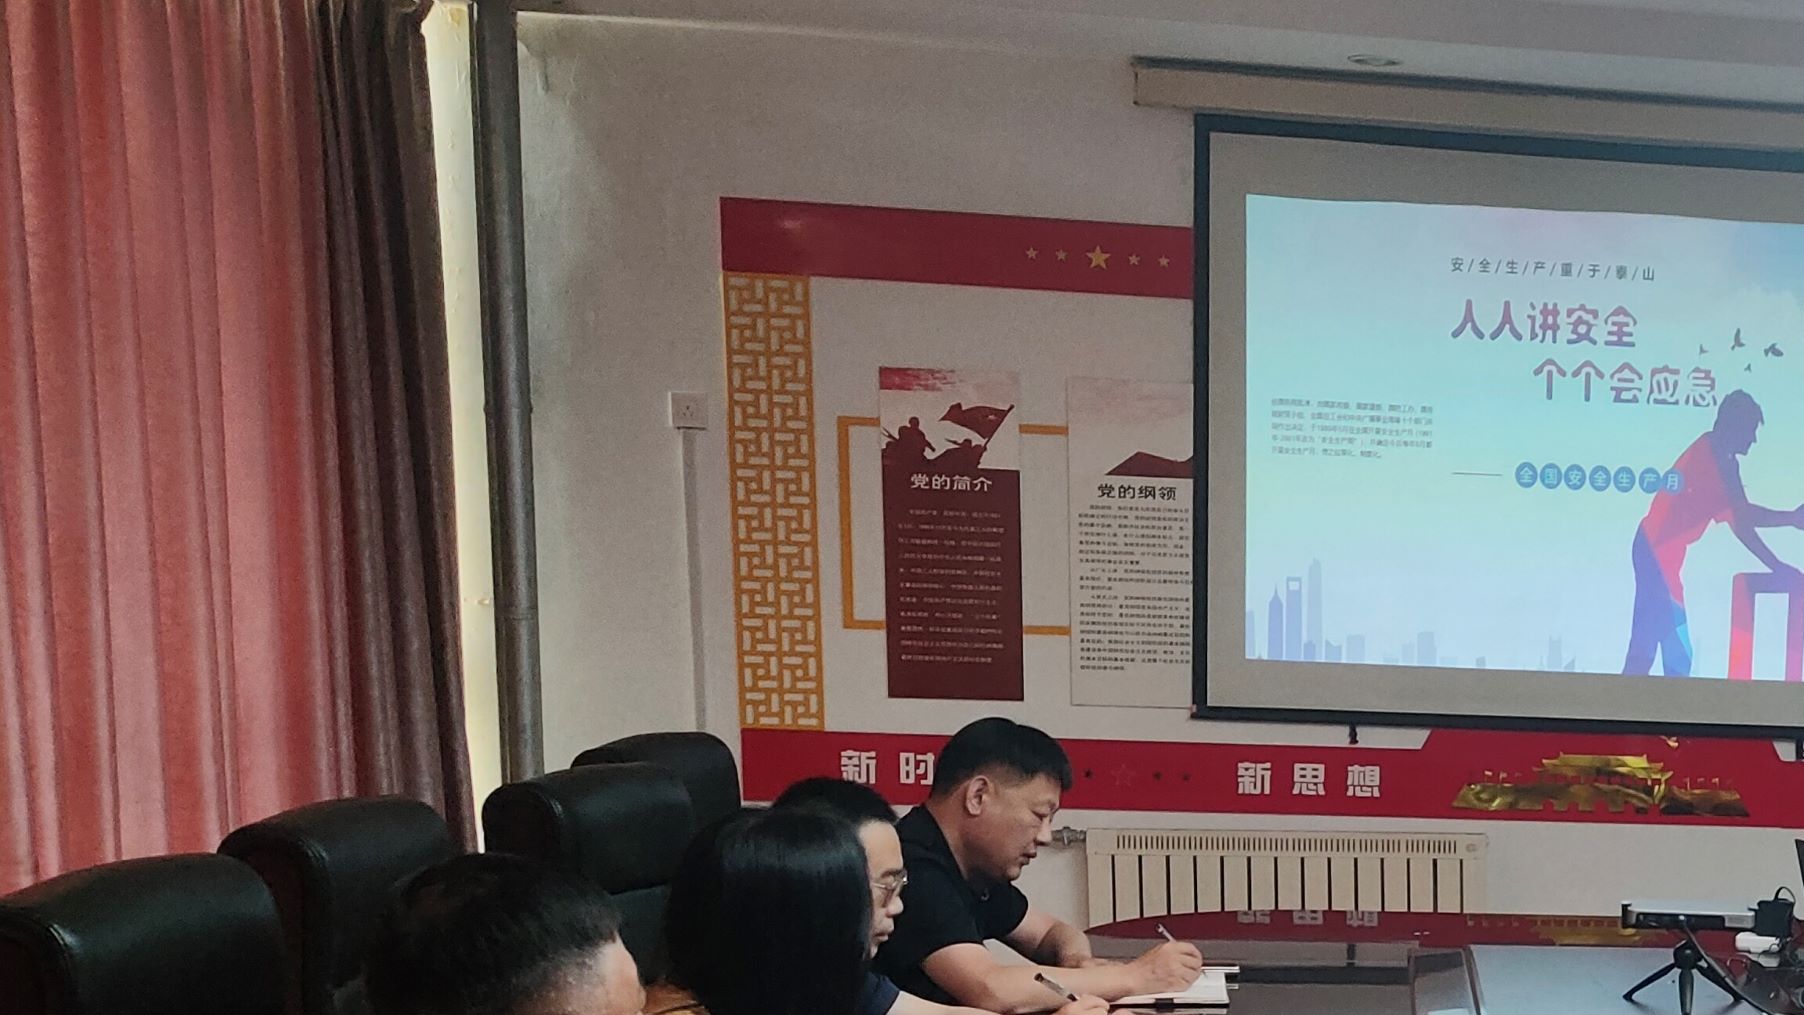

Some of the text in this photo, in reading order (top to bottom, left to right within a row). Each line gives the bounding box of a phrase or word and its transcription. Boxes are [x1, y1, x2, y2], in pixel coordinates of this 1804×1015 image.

[1451, 299, 1637, 347] 人人讲安全
[1533, 358, 1718, 408] 个个会应急
[910, 474, 993, 492] 党的简介
[1097, 482, 1177, 502] 党的纲领
[1518, 466, 1680, 491] 全国安全生产月
[1237, 761, 1381, 798] 新思想
